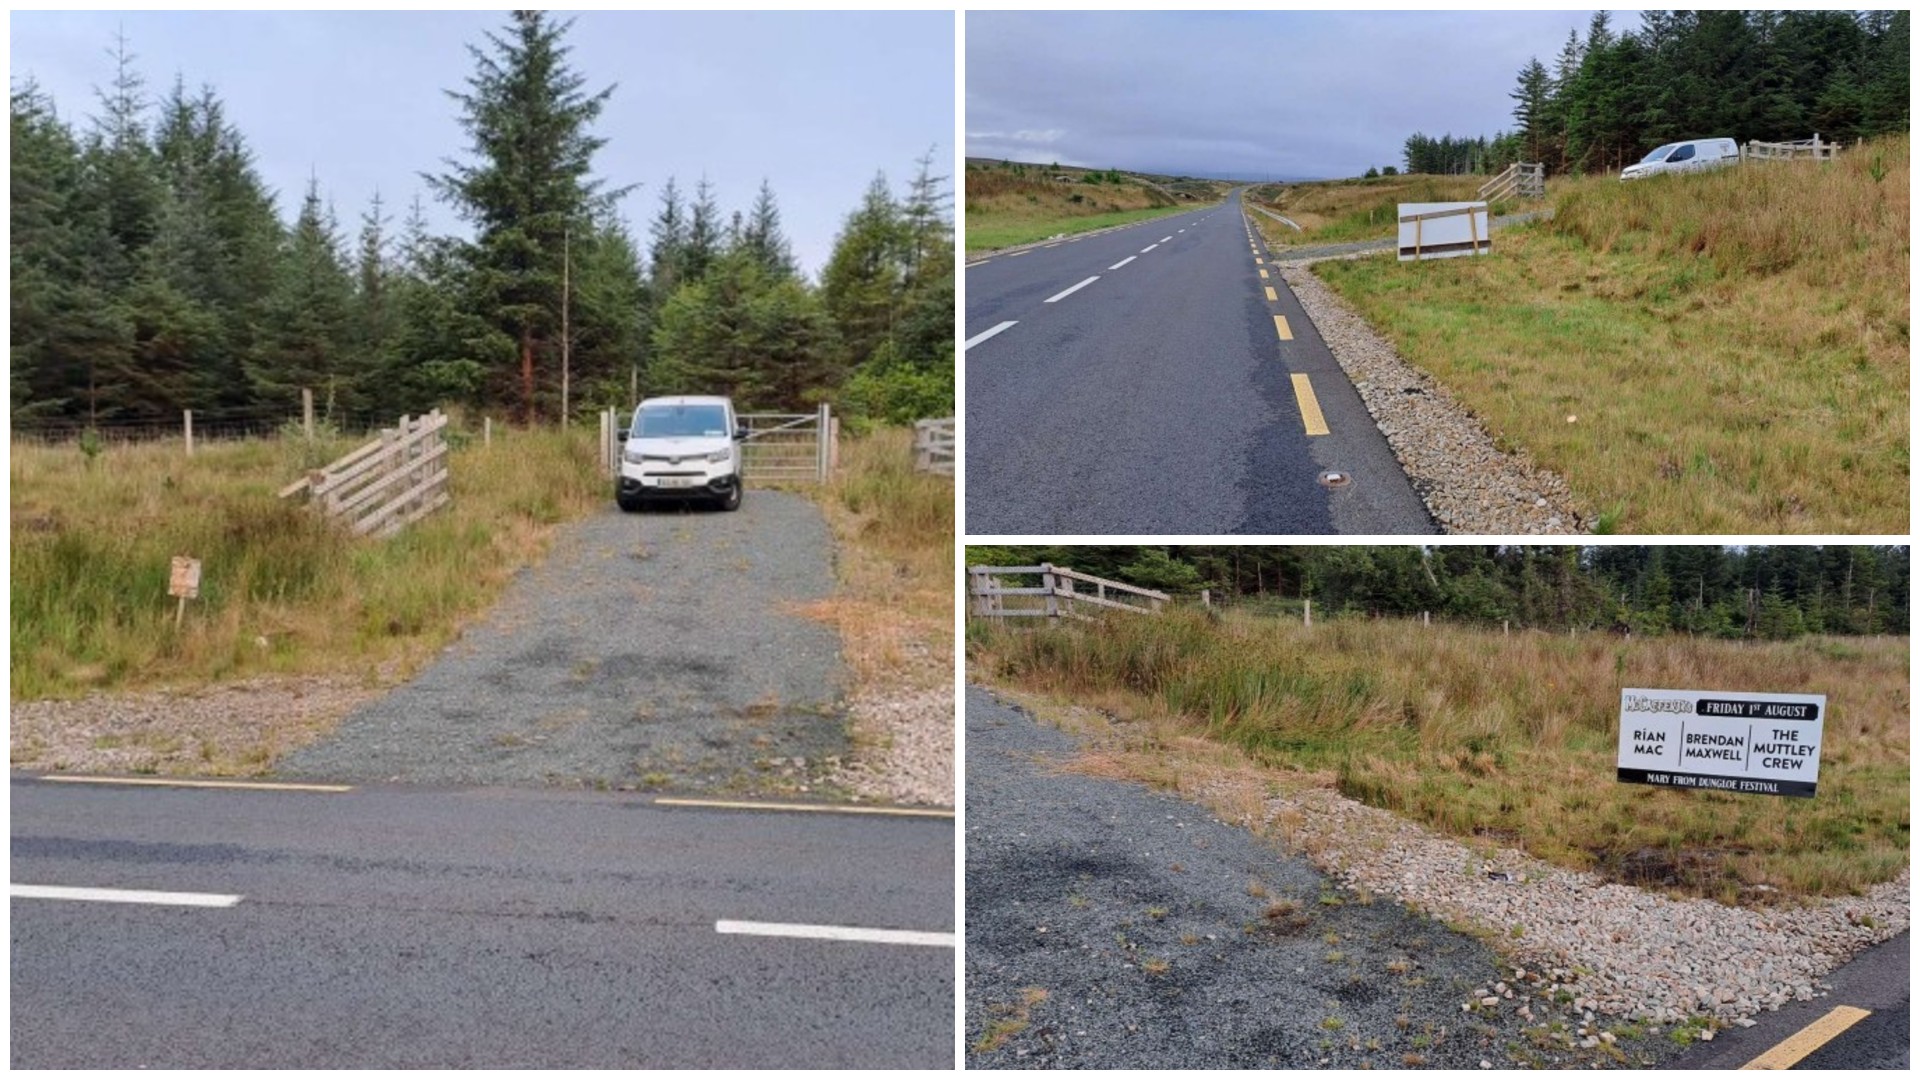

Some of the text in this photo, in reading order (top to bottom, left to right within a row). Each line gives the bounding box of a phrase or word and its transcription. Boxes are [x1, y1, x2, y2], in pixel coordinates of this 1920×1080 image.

[1707, 703, 1744, 714] FRIDAY
[1765, 706, 1807, 717] AUGUST
[1634, 728, 1665, 742] RÍAN
[1686, 734, 1744, 746] BRENDAN
[1772, 730, 1799, 741] THE
[1634, 744, 1663, 755] MAC
[1686, 749, 1742, 760] MAXWELL
[1754, 744, 1815, 756] MUTTLEY
[1763, 758, 1803, 769] CREW
[1647, 773, 1779, 792] MARY FROM DUNGLOE FESTIVAL
